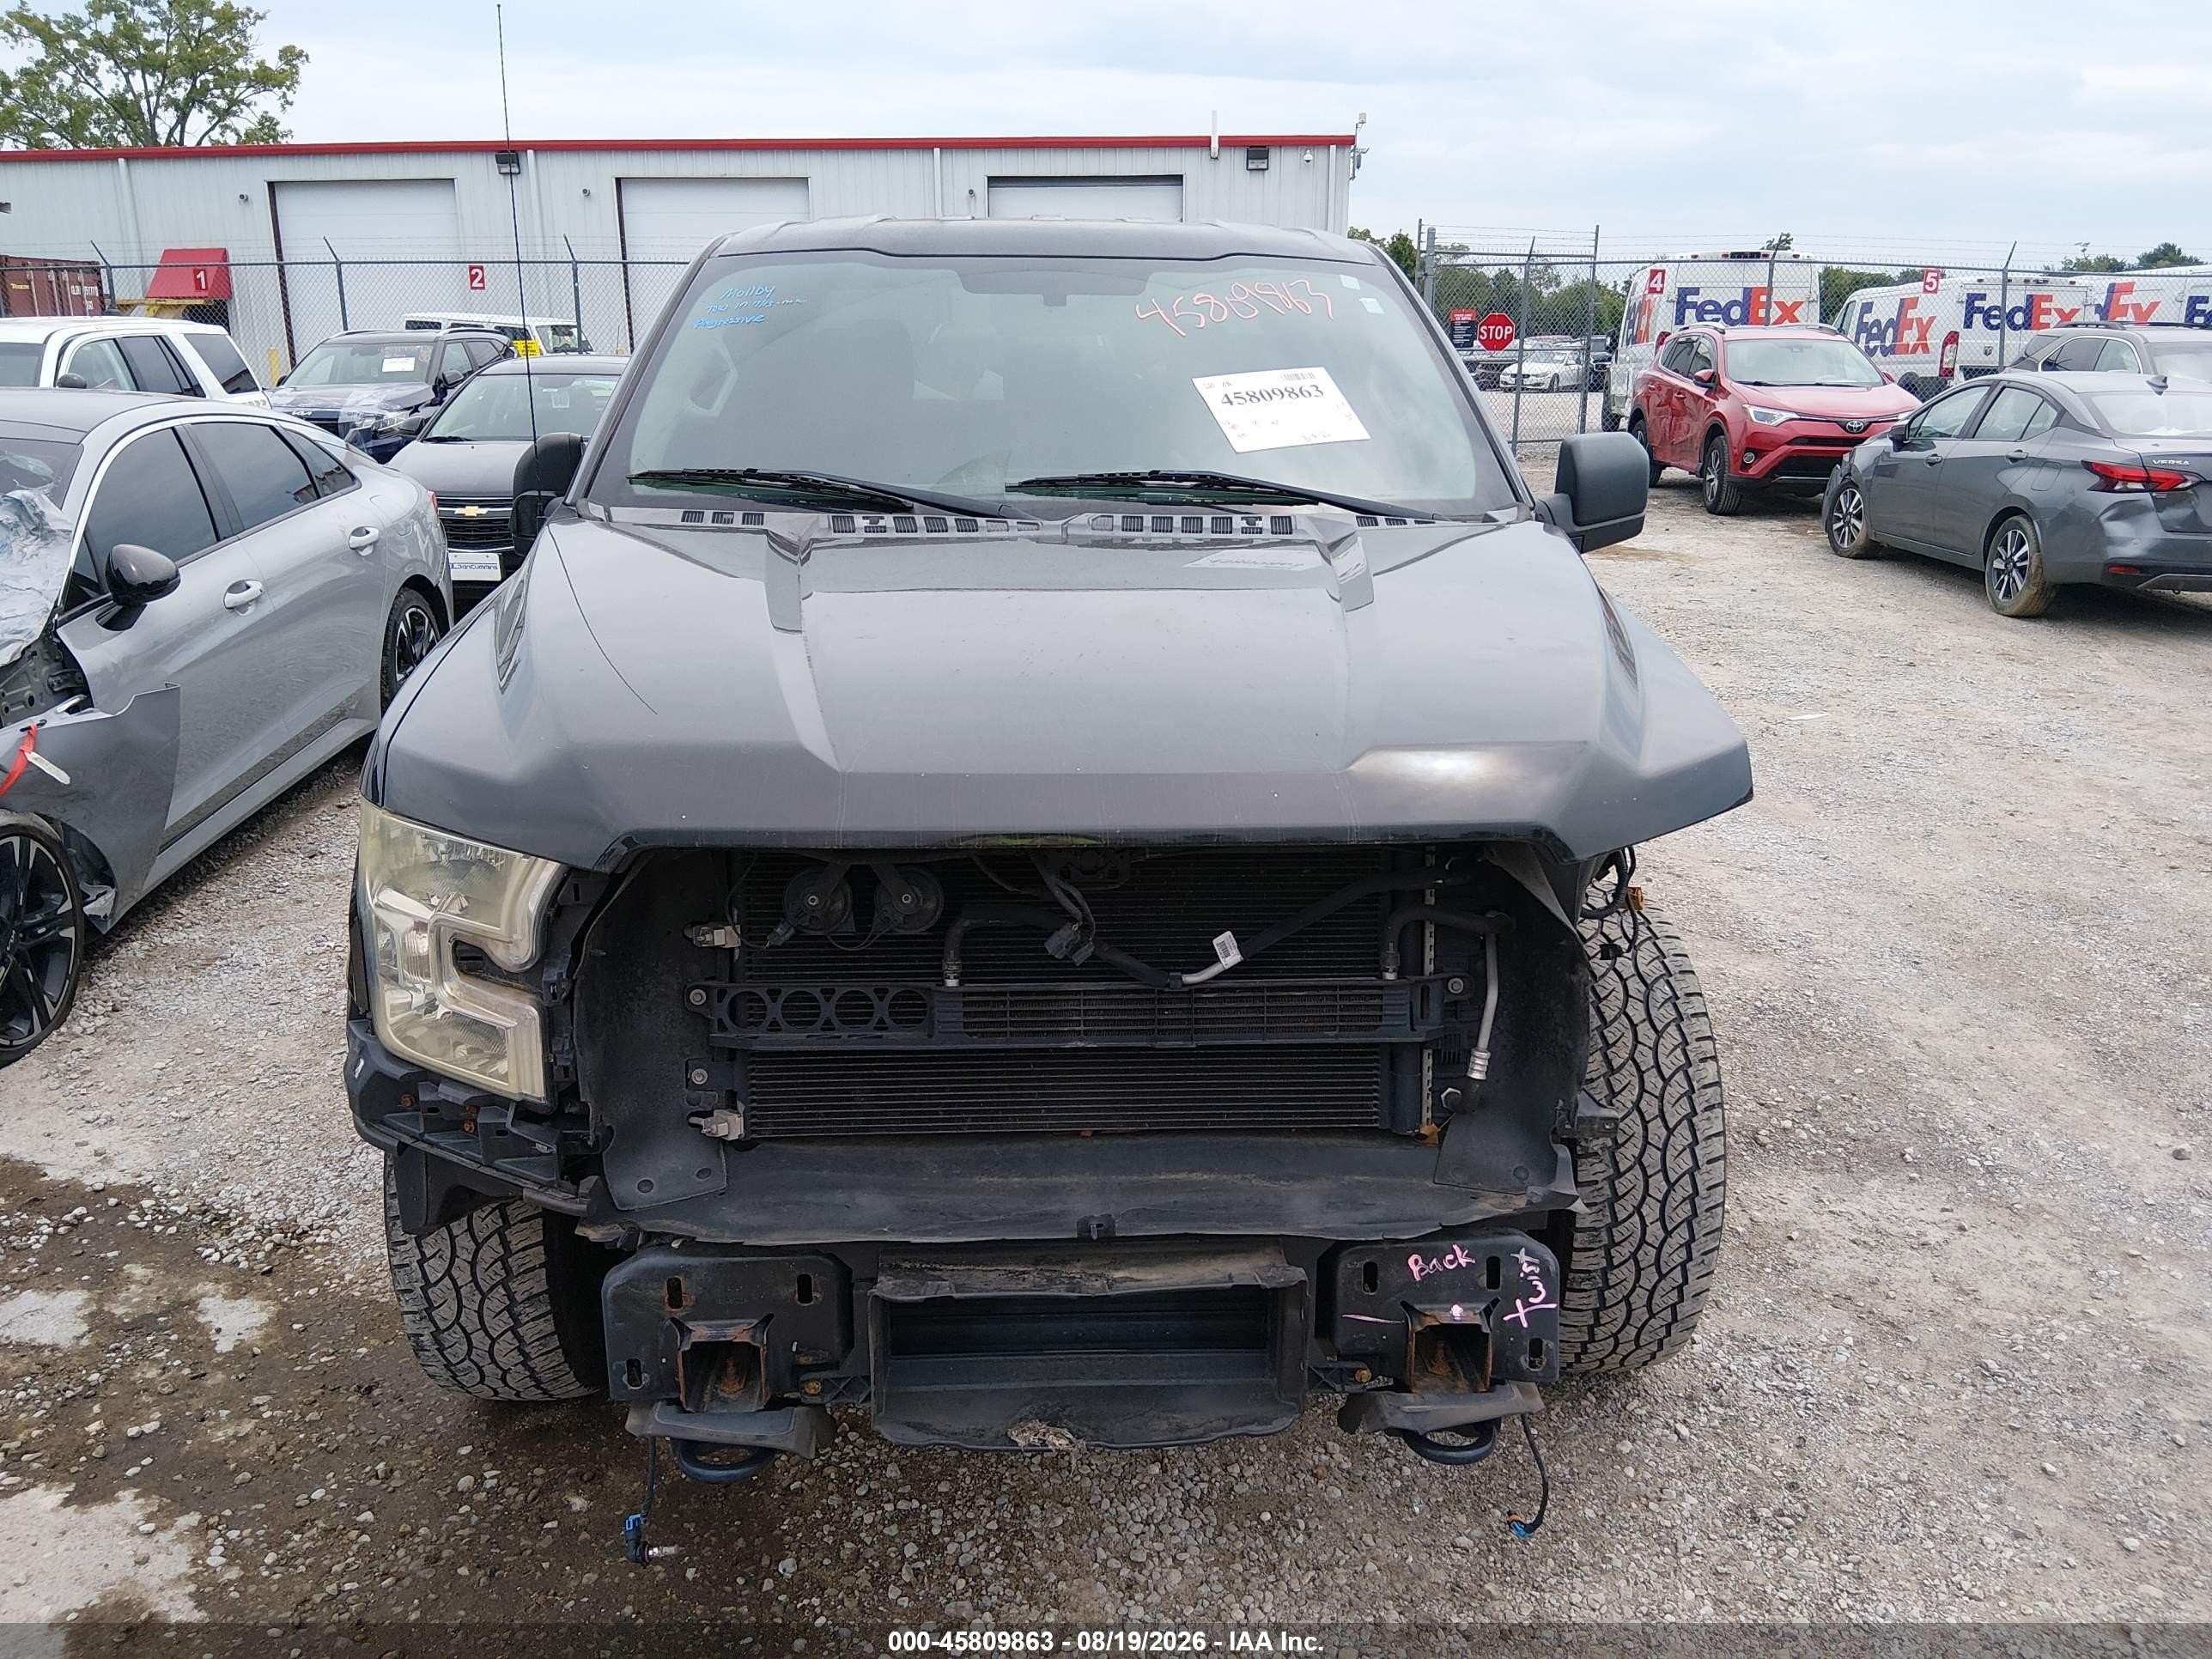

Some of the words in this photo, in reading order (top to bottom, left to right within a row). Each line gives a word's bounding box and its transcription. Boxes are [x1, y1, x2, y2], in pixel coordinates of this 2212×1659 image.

[196, 270, 206, 289] 1
[471, 268, 483, 288] 2
[1650, 271, 1663, 292] 4
[1925, 272, 1938, 291] 5
[1674, 287, 1805, 326] FedEx
[1963, 293, 2081, 331] FedEx
[1480, 325, 1513, 340] STOP
[1854, 297, 1936, 358] FedEx
[1221, 384, 1324, 406] 45809863
[1407, 1243, 1476, 1282] Back
